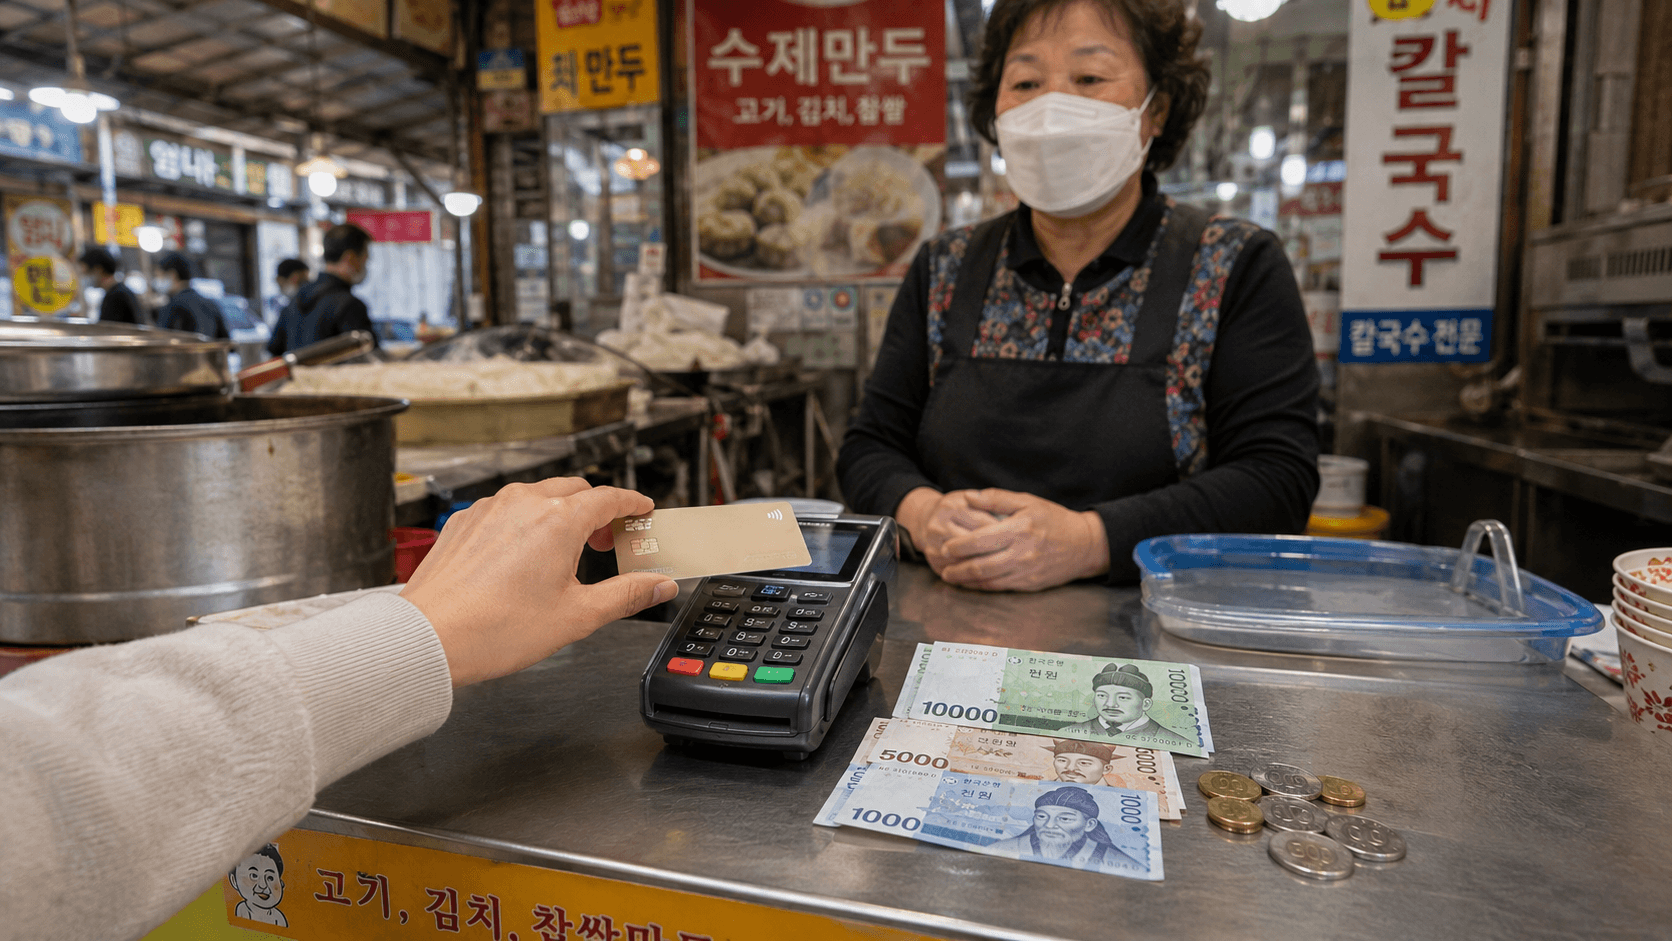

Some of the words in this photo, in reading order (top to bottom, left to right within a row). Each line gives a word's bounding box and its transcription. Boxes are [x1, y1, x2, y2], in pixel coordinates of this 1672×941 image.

[706, 26, 932, 87] 수제만두
[732, 95, 794, 126] 고기,
[796, 95, 855, 126] 김치,
[855, 94, 908, 126] 찹쌀
[1376, 29, 1471, 287] 칼국수
[1350, 318, 1430, 357] 칼국수
[1432, 317, 1484, 356] 전문
[1167, 669, 1189, 703] 10000
[922, 700, 998, 724] 10000
[879, 749, 949, 771] 5000
[852, 807, 921, 832] 1000
[1120, 794, 1142, 825] 1000
[313, 868, 410, 925] 고기,
[424, 887, 520, 941] 김치,
